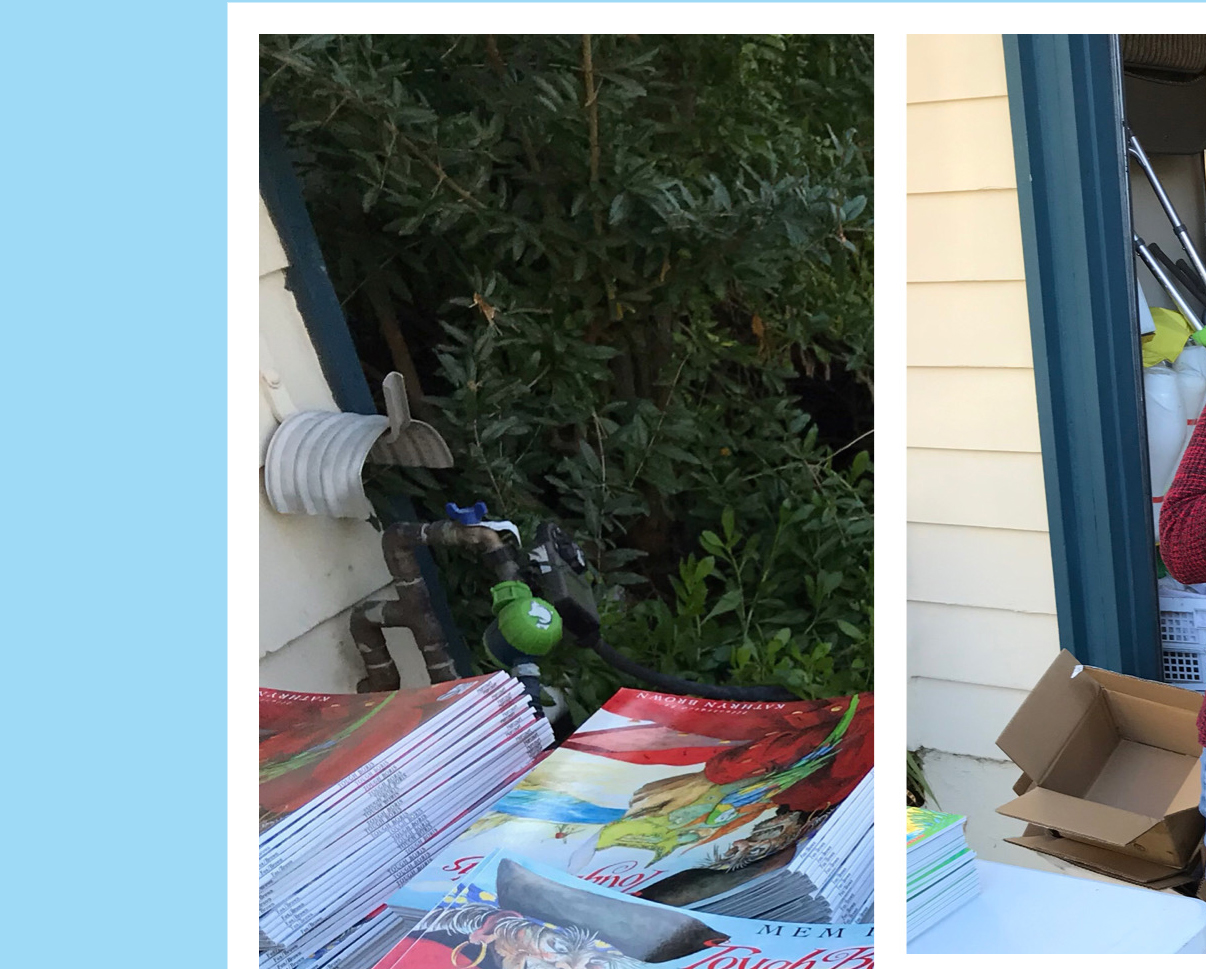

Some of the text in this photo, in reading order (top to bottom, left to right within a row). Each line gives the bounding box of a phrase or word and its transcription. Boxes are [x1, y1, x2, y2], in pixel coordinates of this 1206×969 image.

[636, 691, 785, 710] KATHRYN BROWN
[756, 924, 846, 939] MEM
